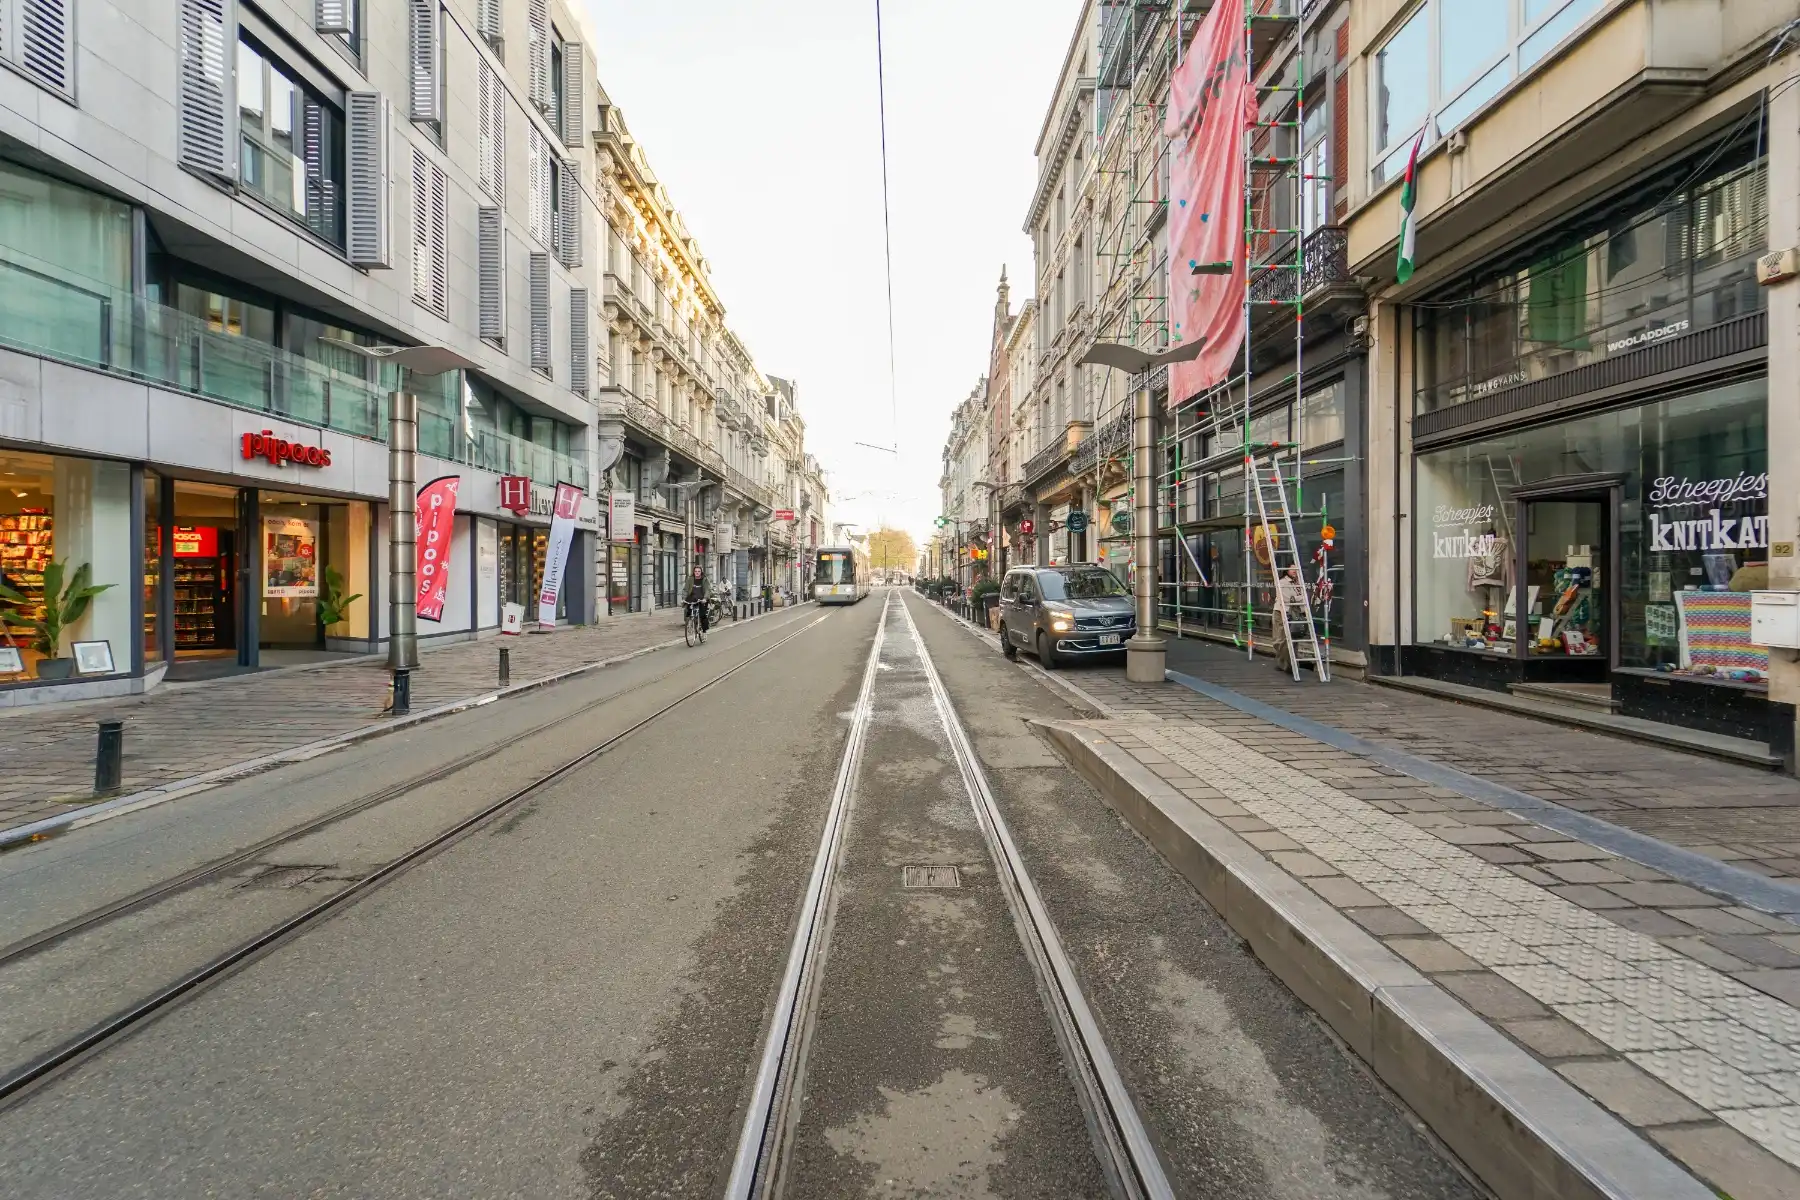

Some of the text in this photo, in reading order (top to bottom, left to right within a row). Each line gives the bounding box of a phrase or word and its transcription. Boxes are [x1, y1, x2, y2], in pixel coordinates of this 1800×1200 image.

[1607, 319, 1689, 352] WOOLADDICTS
[242, 429, 331, 466] pipoos
[1649, 471, 1767, 502] Scheepjes
[1433, 503, 1492, 525] Scheepjes
[419, 493, 443, 595] pipoos
[1774, 545, 1791, 554] 92
